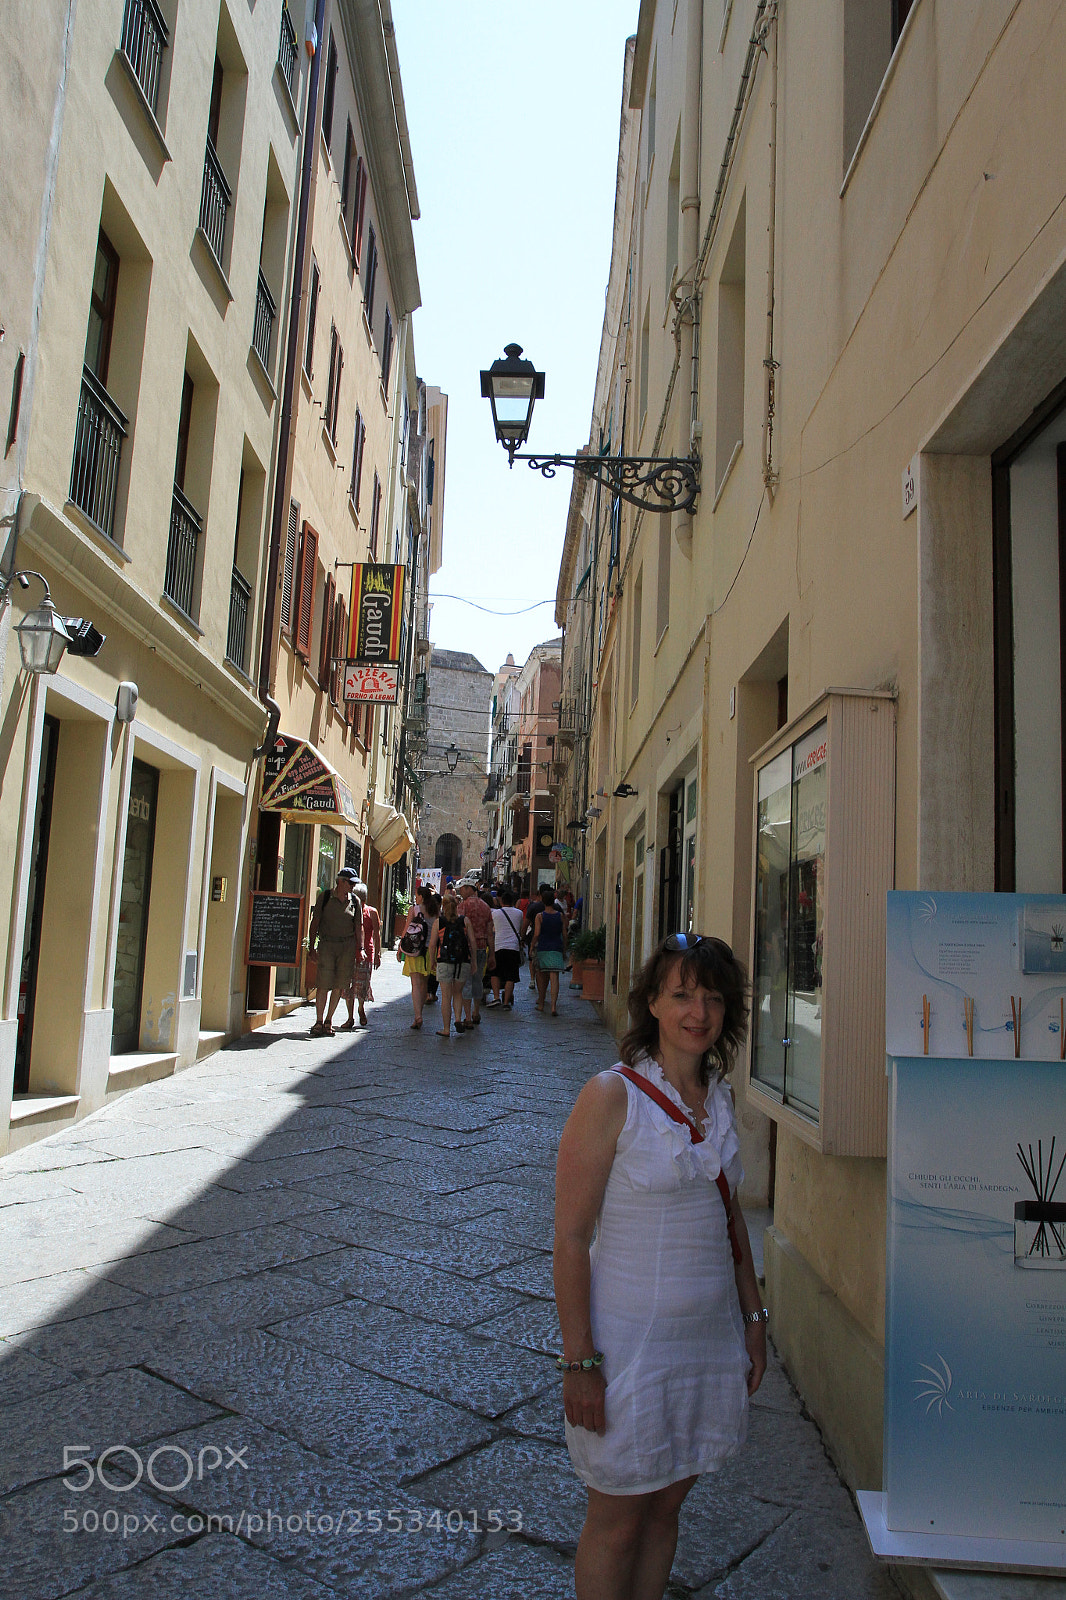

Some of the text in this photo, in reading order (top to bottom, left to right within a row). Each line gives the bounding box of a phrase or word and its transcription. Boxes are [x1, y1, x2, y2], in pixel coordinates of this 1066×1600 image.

[363, 593, 391, 657] Gaudì
[347, 668, 397, 690] PIZZERIA
[347, 692, 368, 700] FORNO
[375, 693, 395, 701] LEGNA
[908, 1172, 937, 1181] CHIUDI
[939, 1174, 952, 1182] GLI
[919, 1182, 942, 1190] SENTI
[943, 1182, 966, 1191] L'ARIA
[958, 1390, 987, 1400] ARIA
[993, 1392, 1007, 1401] DI
[982, 1404, 1016, 1412] ESSENZE
